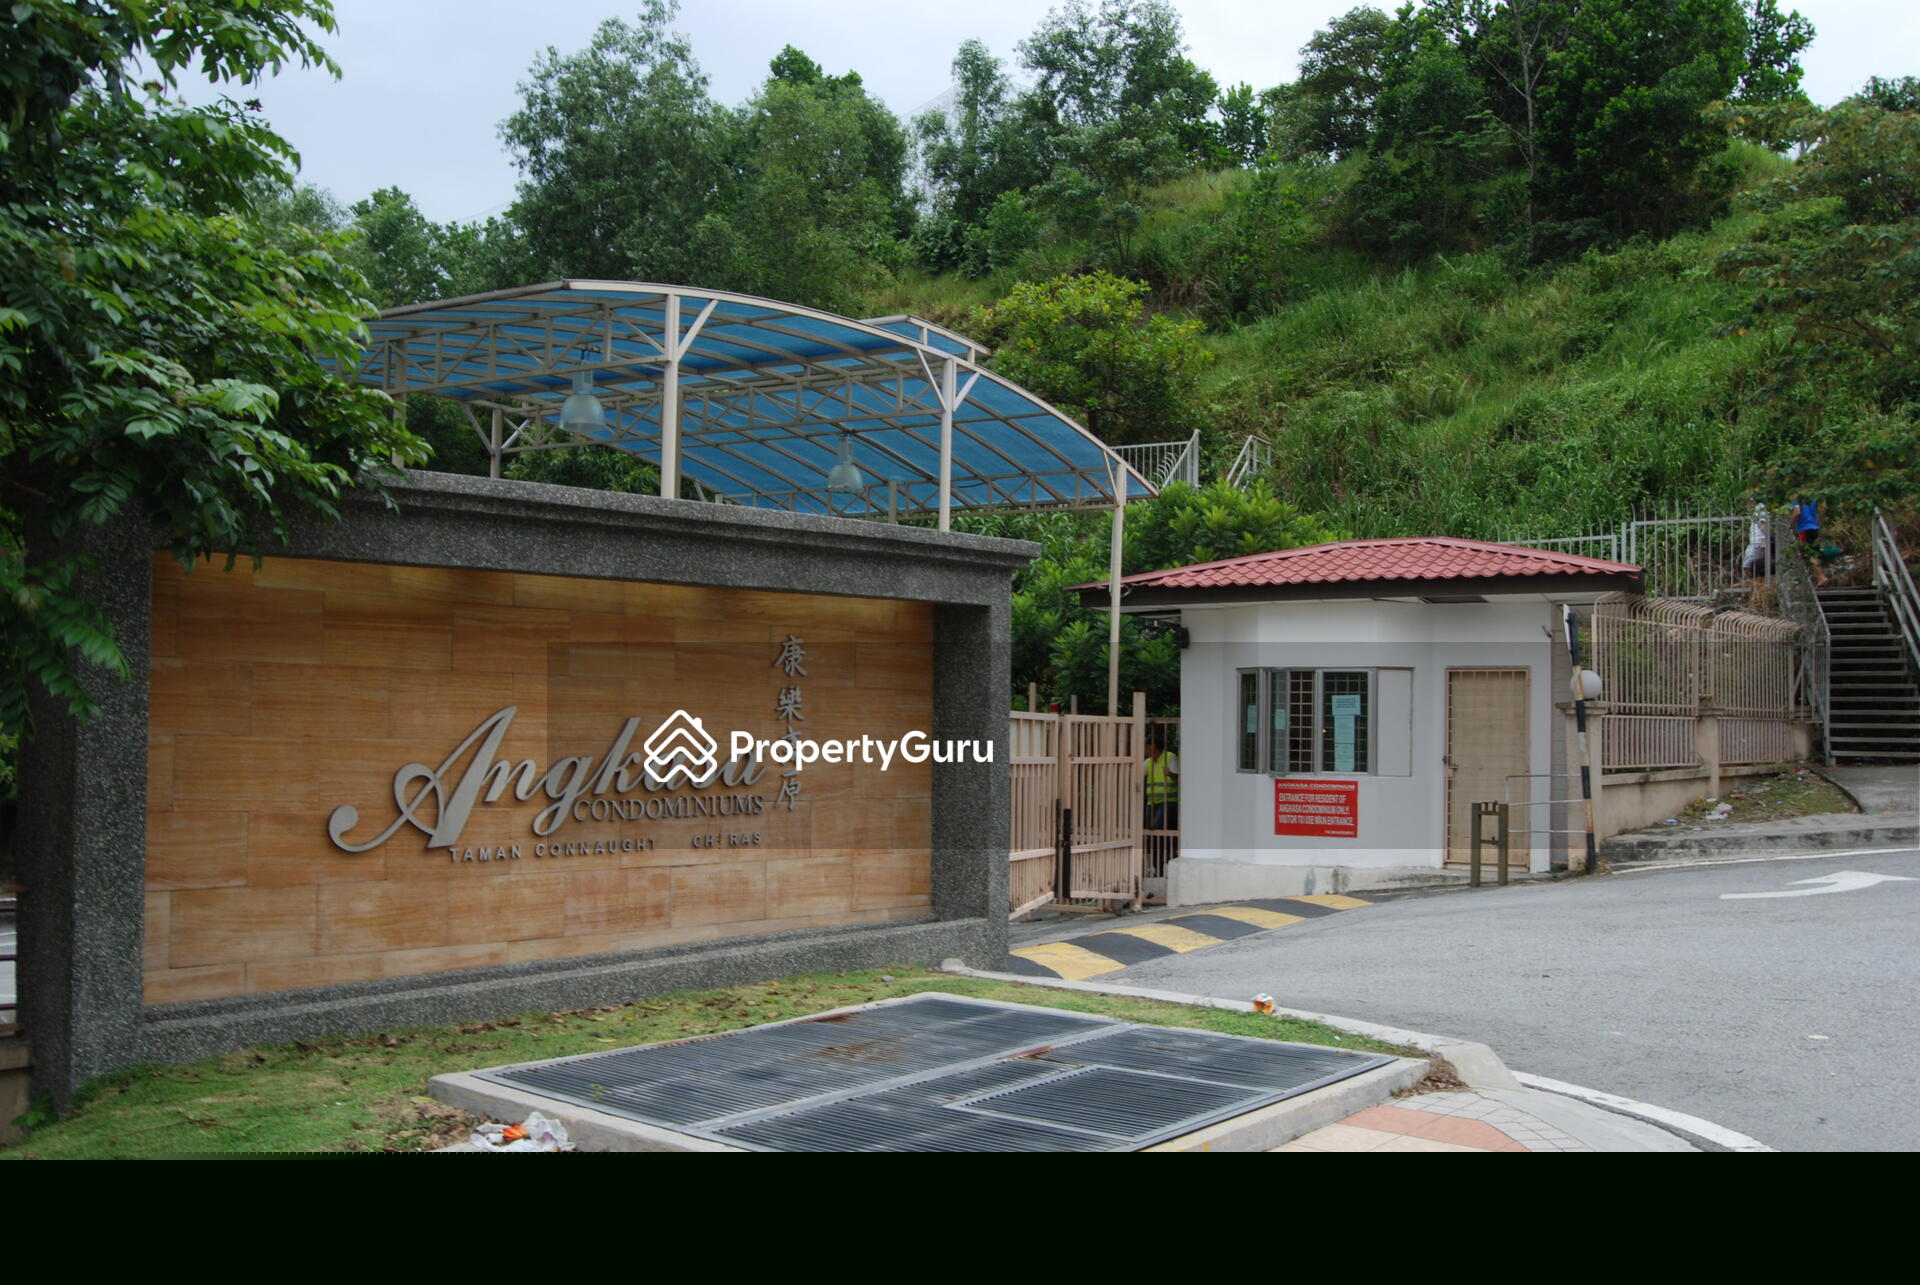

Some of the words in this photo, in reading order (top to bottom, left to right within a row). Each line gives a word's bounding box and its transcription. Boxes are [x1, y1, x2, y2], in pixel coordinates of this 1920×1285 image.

[573, 795, 765, 821] CONDOMINIUMS
[450, 847, 522, 863] TAMAN
[535, 839, 658, 858] CONNAUGHT
[692, 832, 762, 849] CHRAS
